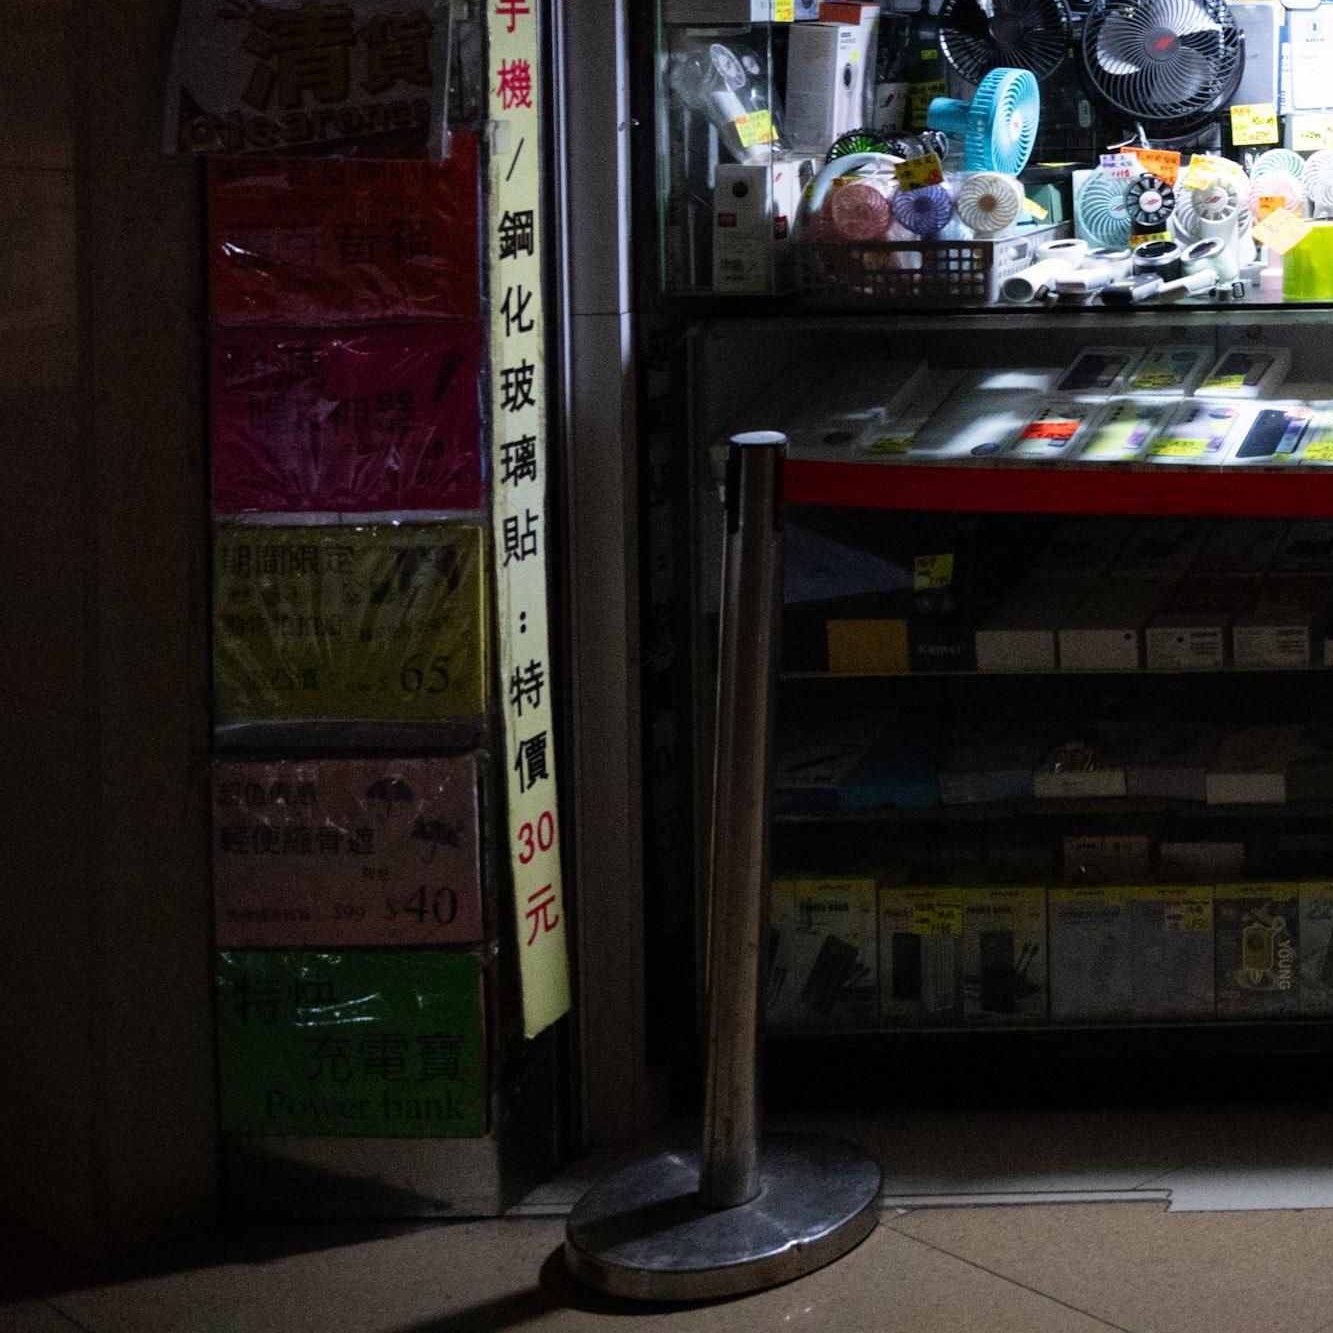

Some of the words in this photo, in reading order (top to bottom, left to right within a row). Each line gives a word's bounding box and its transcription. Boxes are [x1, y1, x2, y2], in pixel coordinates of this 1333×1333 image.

[242, 0, 435, 111] 清貨
[1277, 939, 1291, 990] YOUNG
[305, 1031, 465, 1083] 充電寶
[264, 1089, 370, 1120] Power
[382, 1089, 465, 1121] bank
